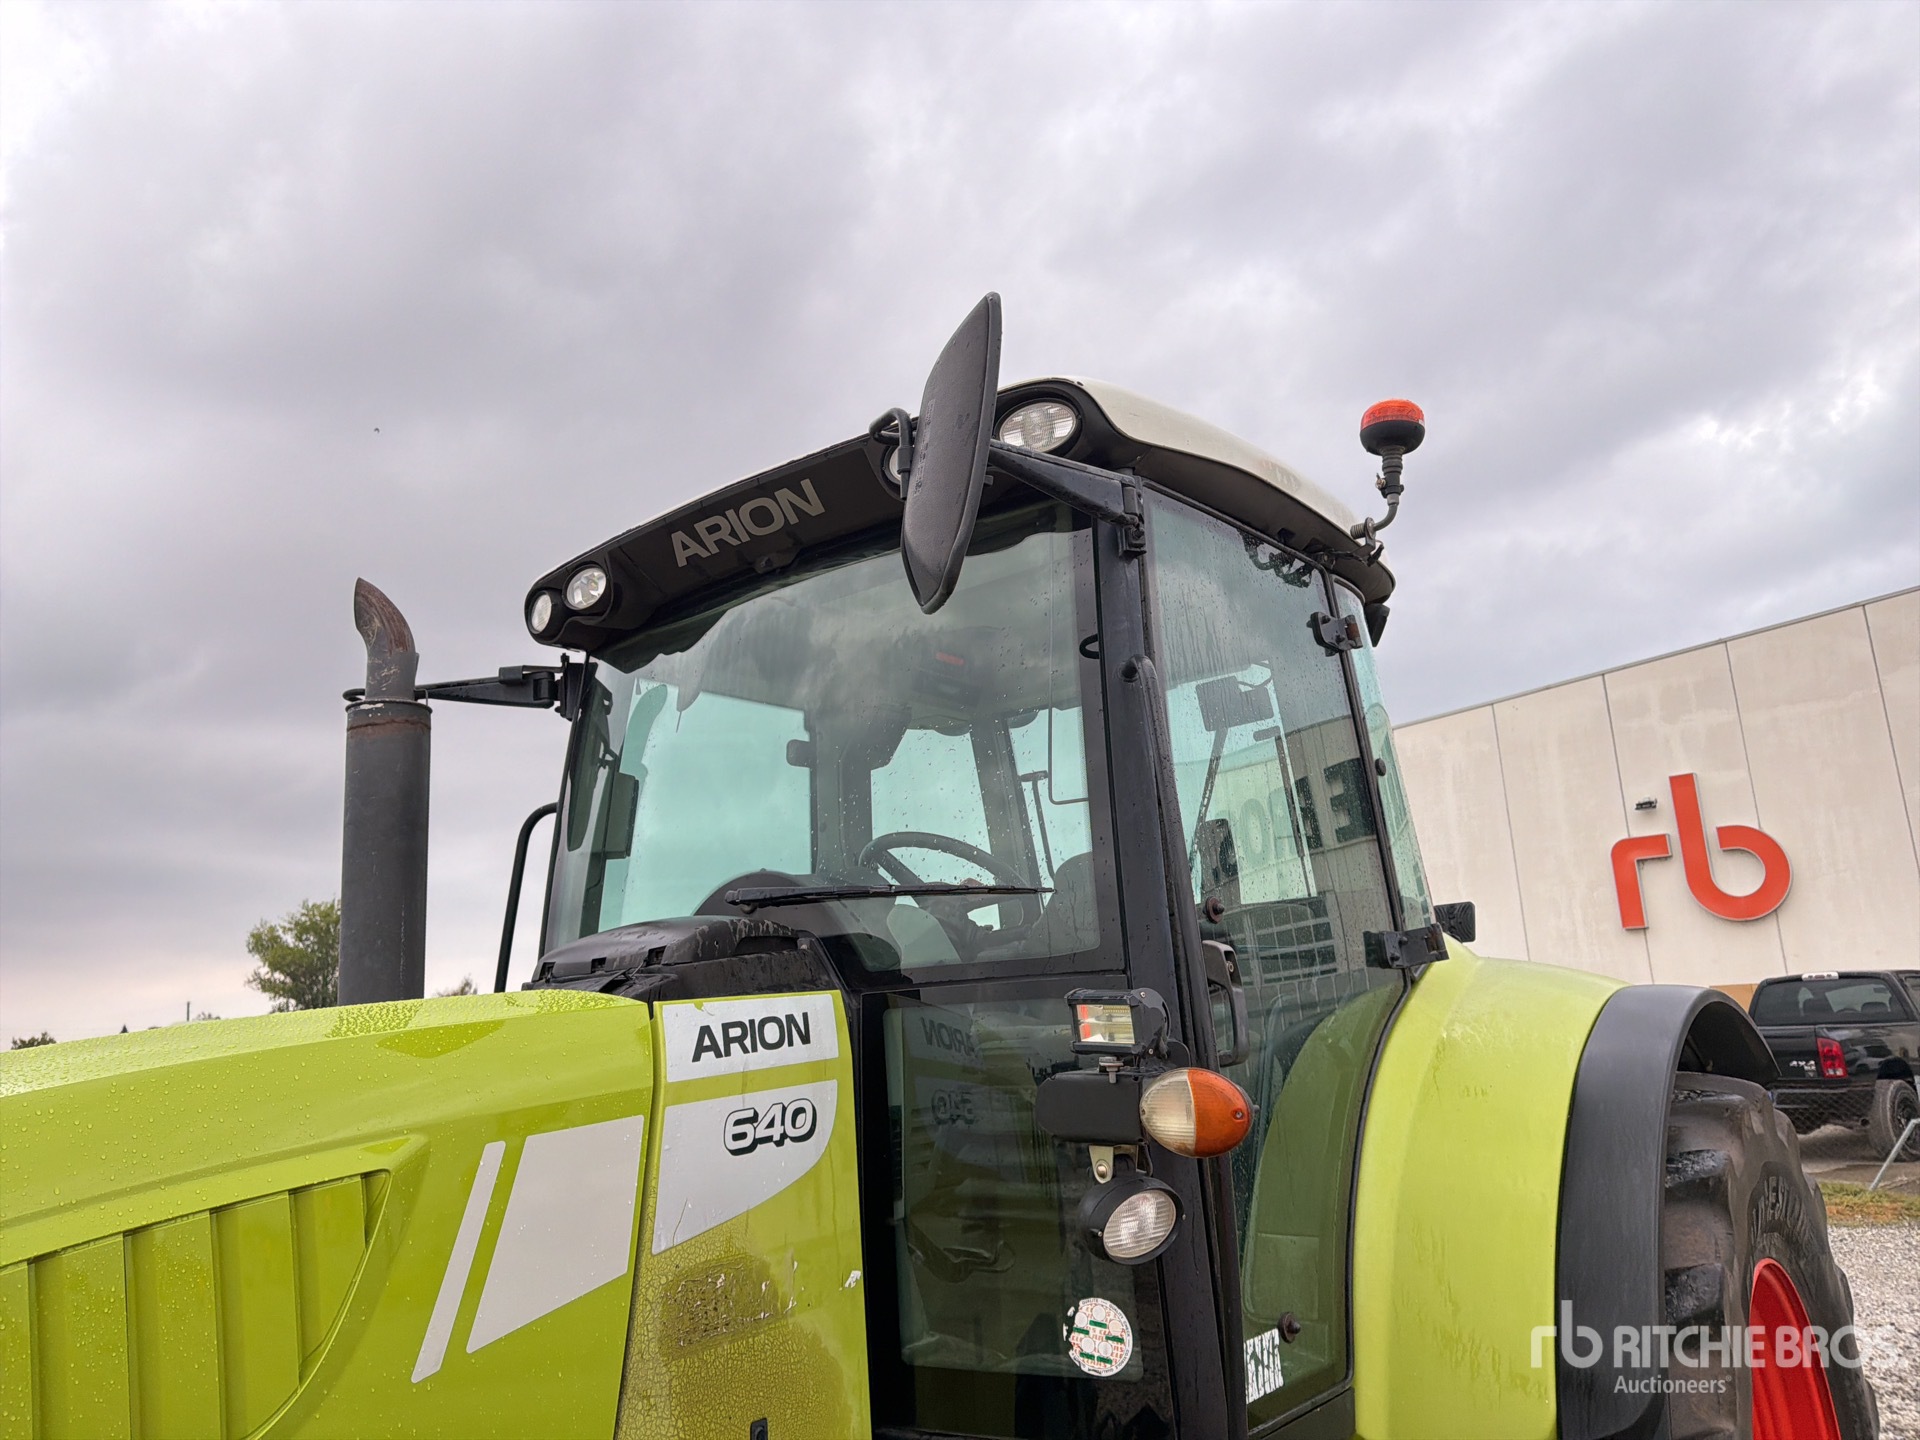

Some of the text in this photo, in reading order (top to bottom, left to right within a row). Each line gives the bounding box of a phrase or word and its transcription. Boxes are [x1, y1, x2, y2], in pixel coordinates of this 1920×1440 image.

[671, 478, 825, 567] ARION
[1611, 772, 1793, 930] rb
[692, 1011, 811, 1063] ARION
[723, 1098, 817, 1156] 640
